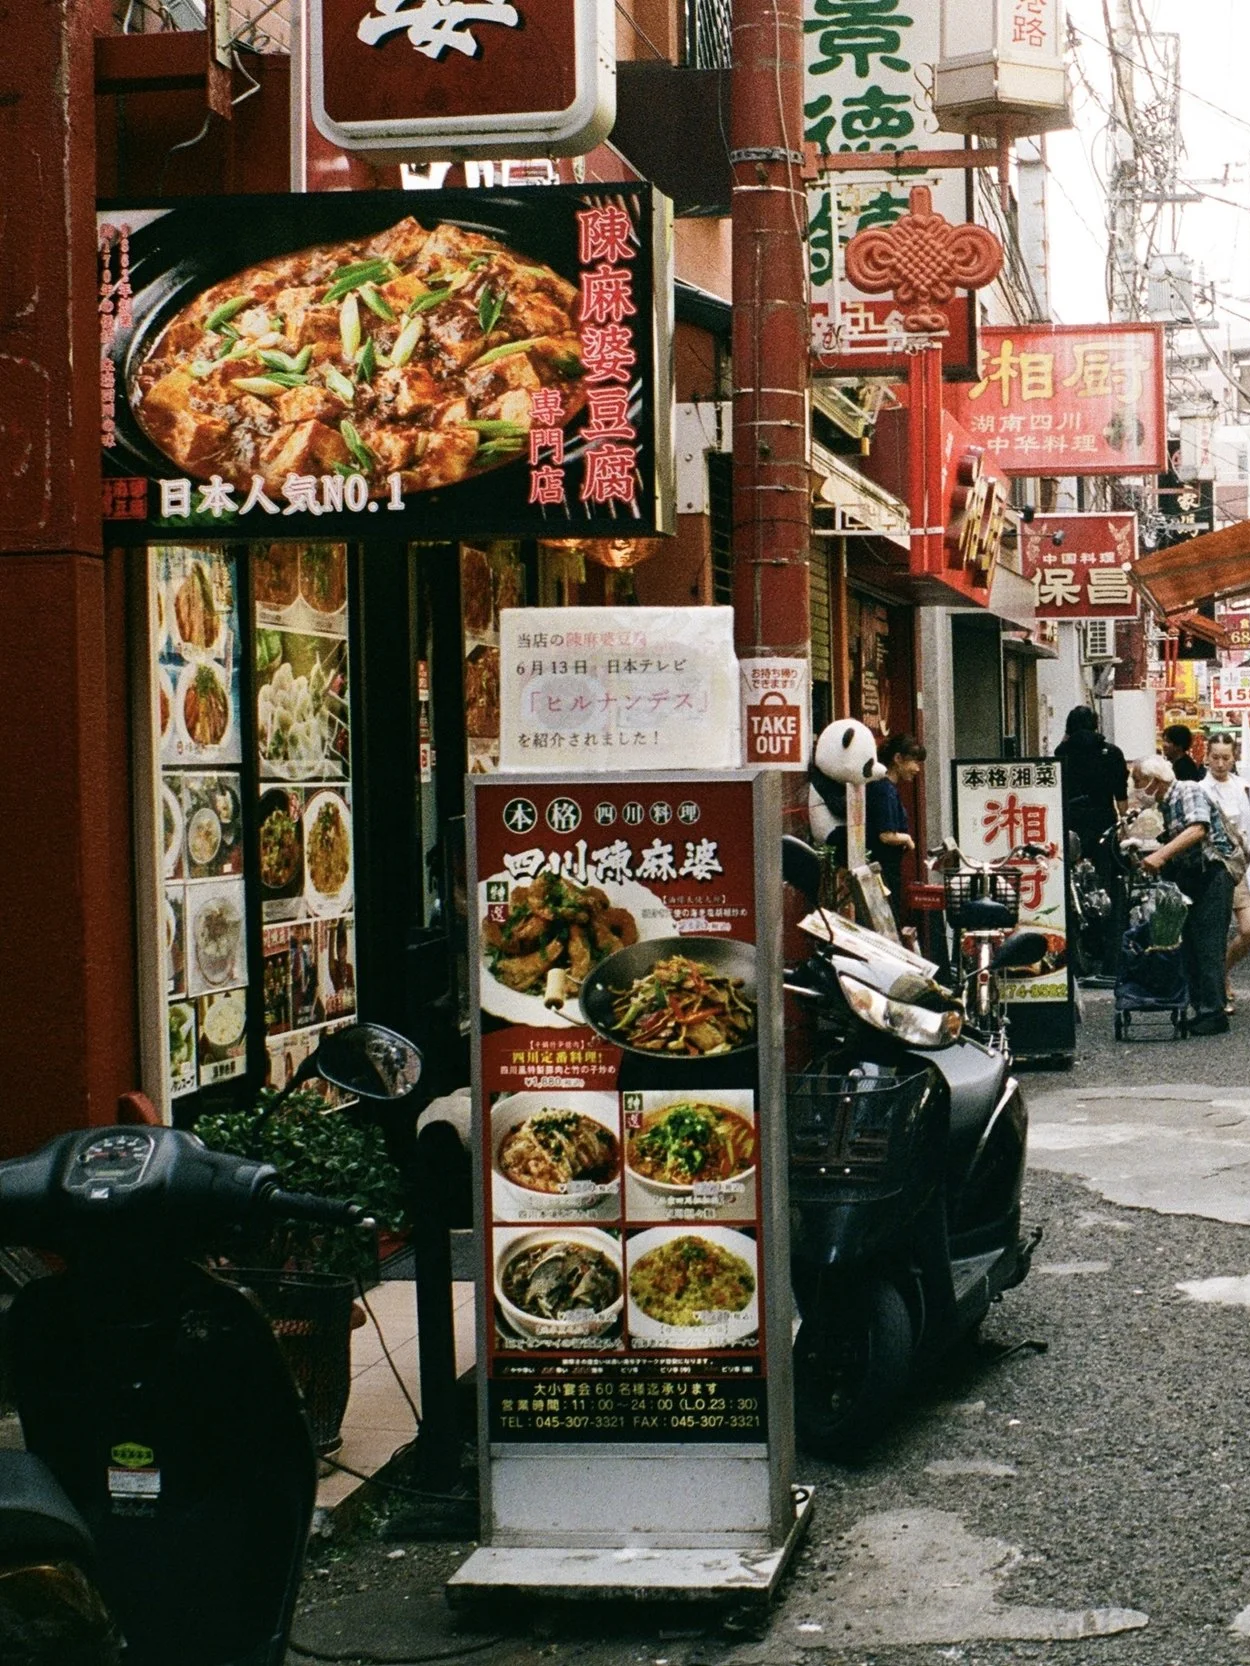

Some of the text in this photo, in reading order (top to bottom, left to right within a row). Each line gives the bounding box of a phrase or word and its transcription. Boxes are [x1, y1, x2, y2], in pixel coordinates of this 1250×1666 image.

[577, 205, 636, 502] 陳麻婆豆腐
[971, 412, 1081, 434] 湖南四川
[528, 388, 565, 504] 専門店
[159, 472, 406, 518] 日本人気NO.1
[607, 658, 687, 674] 日本テレビ
[751, 668, 798, 680] お持ち帰り
[751, 716, 797, 735] TAKE
[756, 736, 793, 755] OUT
[963, 766, 1058, 787] 本格湘菜
[503, 838, 724, 884] 四川陳麻婆
